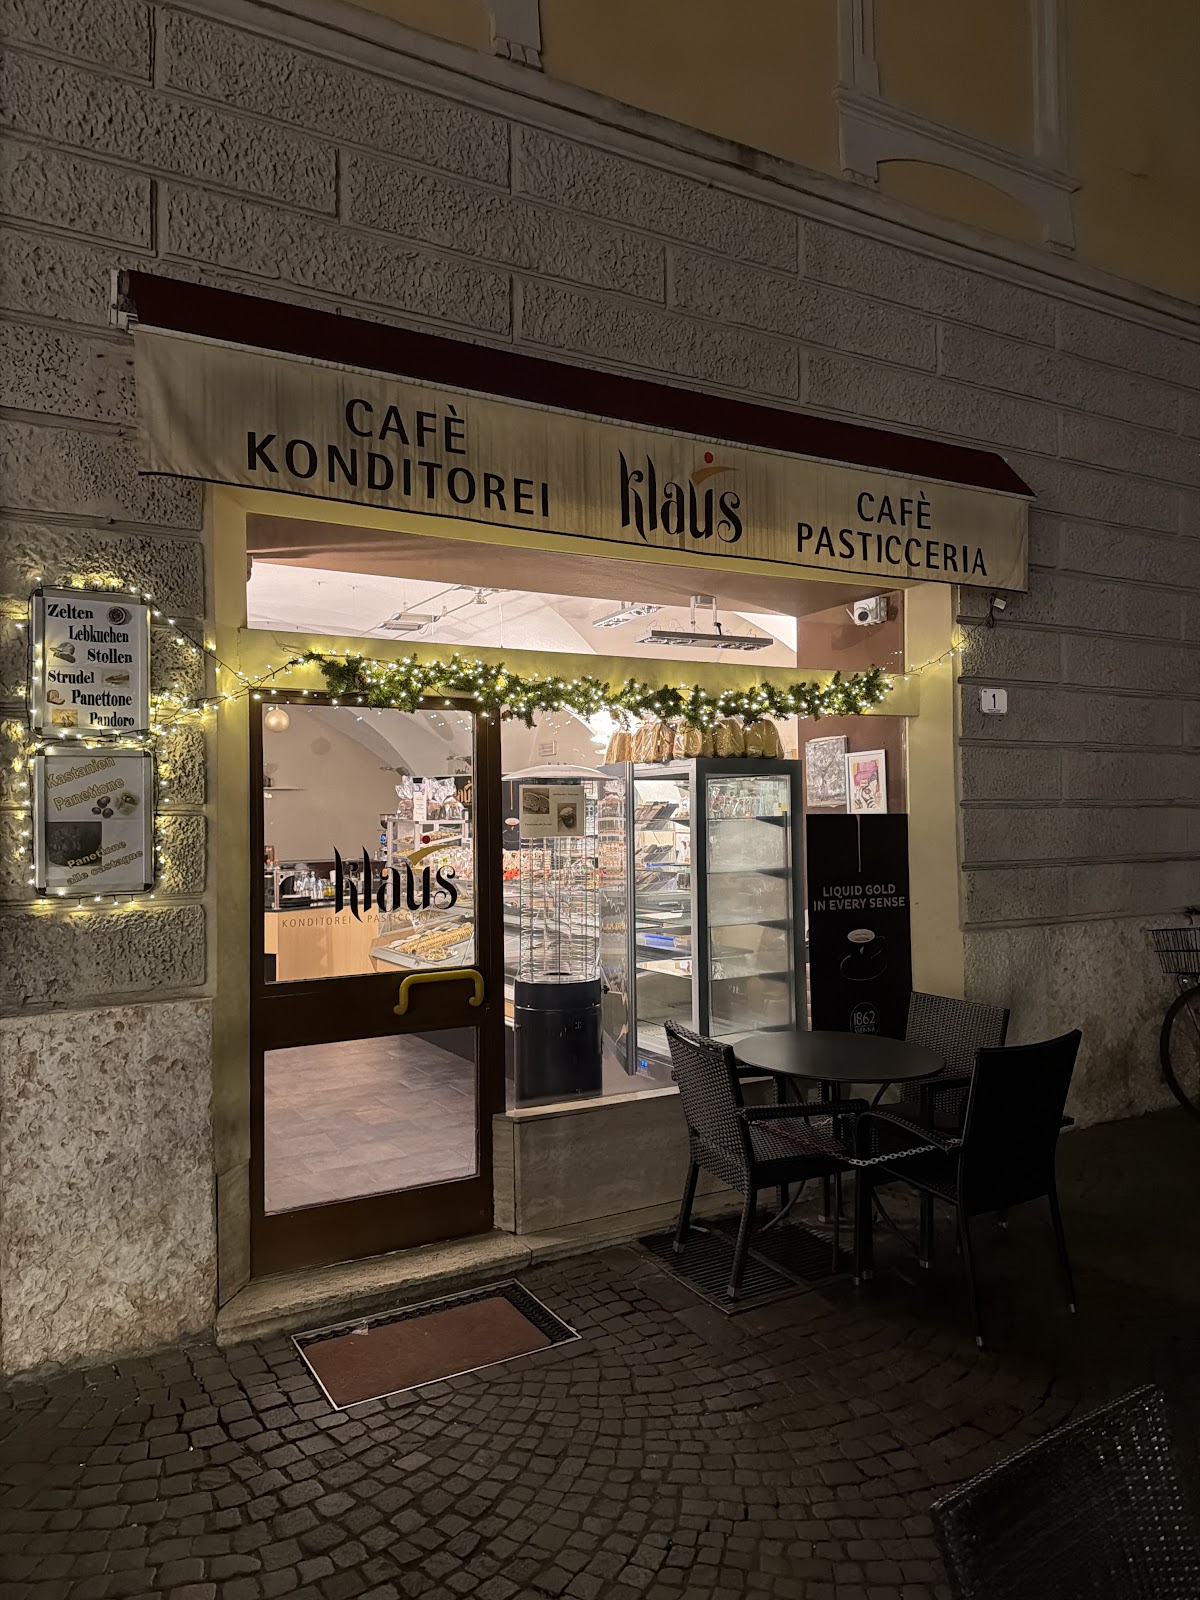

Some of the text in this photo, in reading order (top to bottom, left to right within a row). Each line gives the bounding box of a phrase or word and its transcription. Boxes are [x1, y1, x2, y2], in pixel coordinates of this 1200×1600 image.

[344, 398, 467, 455] CAFÈ
[247, 431, 550, 517] KONDITOREI
[618, 448, 743, 544] klaus
[856, 490, 932, 530] CAFÈ
[797, 522, 988, 577] PASTICCERIA
[47, 603, 94, 620] Zelten
[68, 624, 130, 643] Lebkuchen
[87, 648, 133, 664] Stollen
[47, 669, 95, 684] Strudel
[71, 689, 133, 706] Panettone
[992, 694, 996, 708] 1
[89, 711, 135, 727] Pandoro
[45, 756, 116, 789] Kastanien
[53, 777, 125, 811] Panettone
[66, 840, 127, 869] Panettone
[66, 849, 144, 885] alle castagne
[333, 845, 457, 923] klaus
[823, 883, 896, 898] LIQUID GOLD
[813, 896, 906, 911] IN EVERY SENSE
[281, 912, 436, 928] KONDITOREI PASTICCERIA
[853, 1011, 875, 1025] 1862
